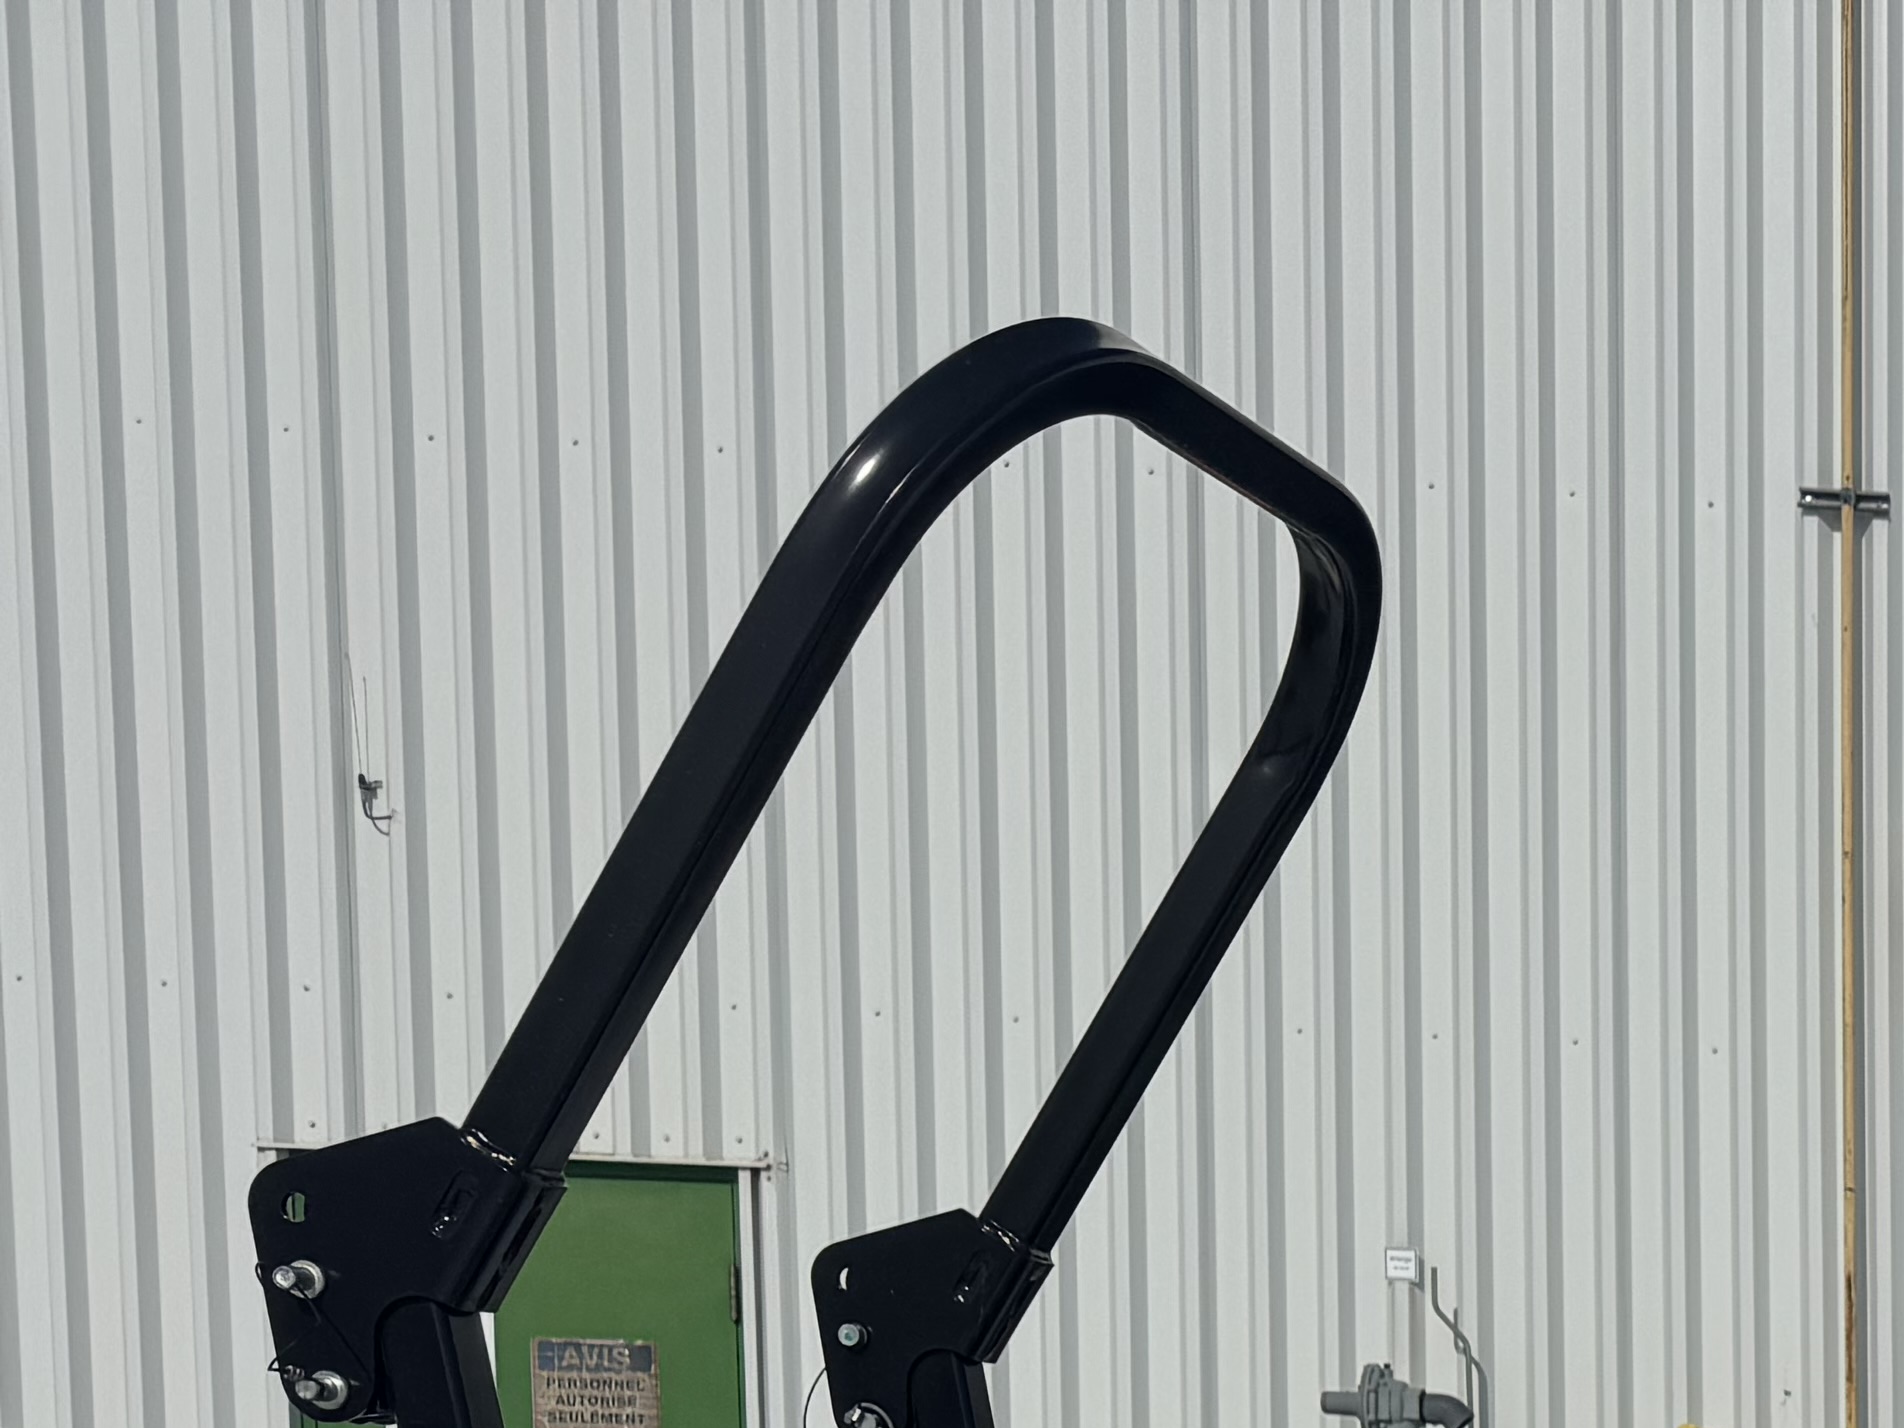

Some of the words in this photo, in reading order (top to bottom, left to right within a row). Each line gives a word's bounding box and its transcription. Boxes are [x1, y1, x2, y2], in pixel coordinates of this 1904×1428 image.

[561, 1344, 631, 1368] AVIS
[546, 1376, 646, 1392] PERSONNEL
[547, 1410, 646, 1425] SEULEMENT
